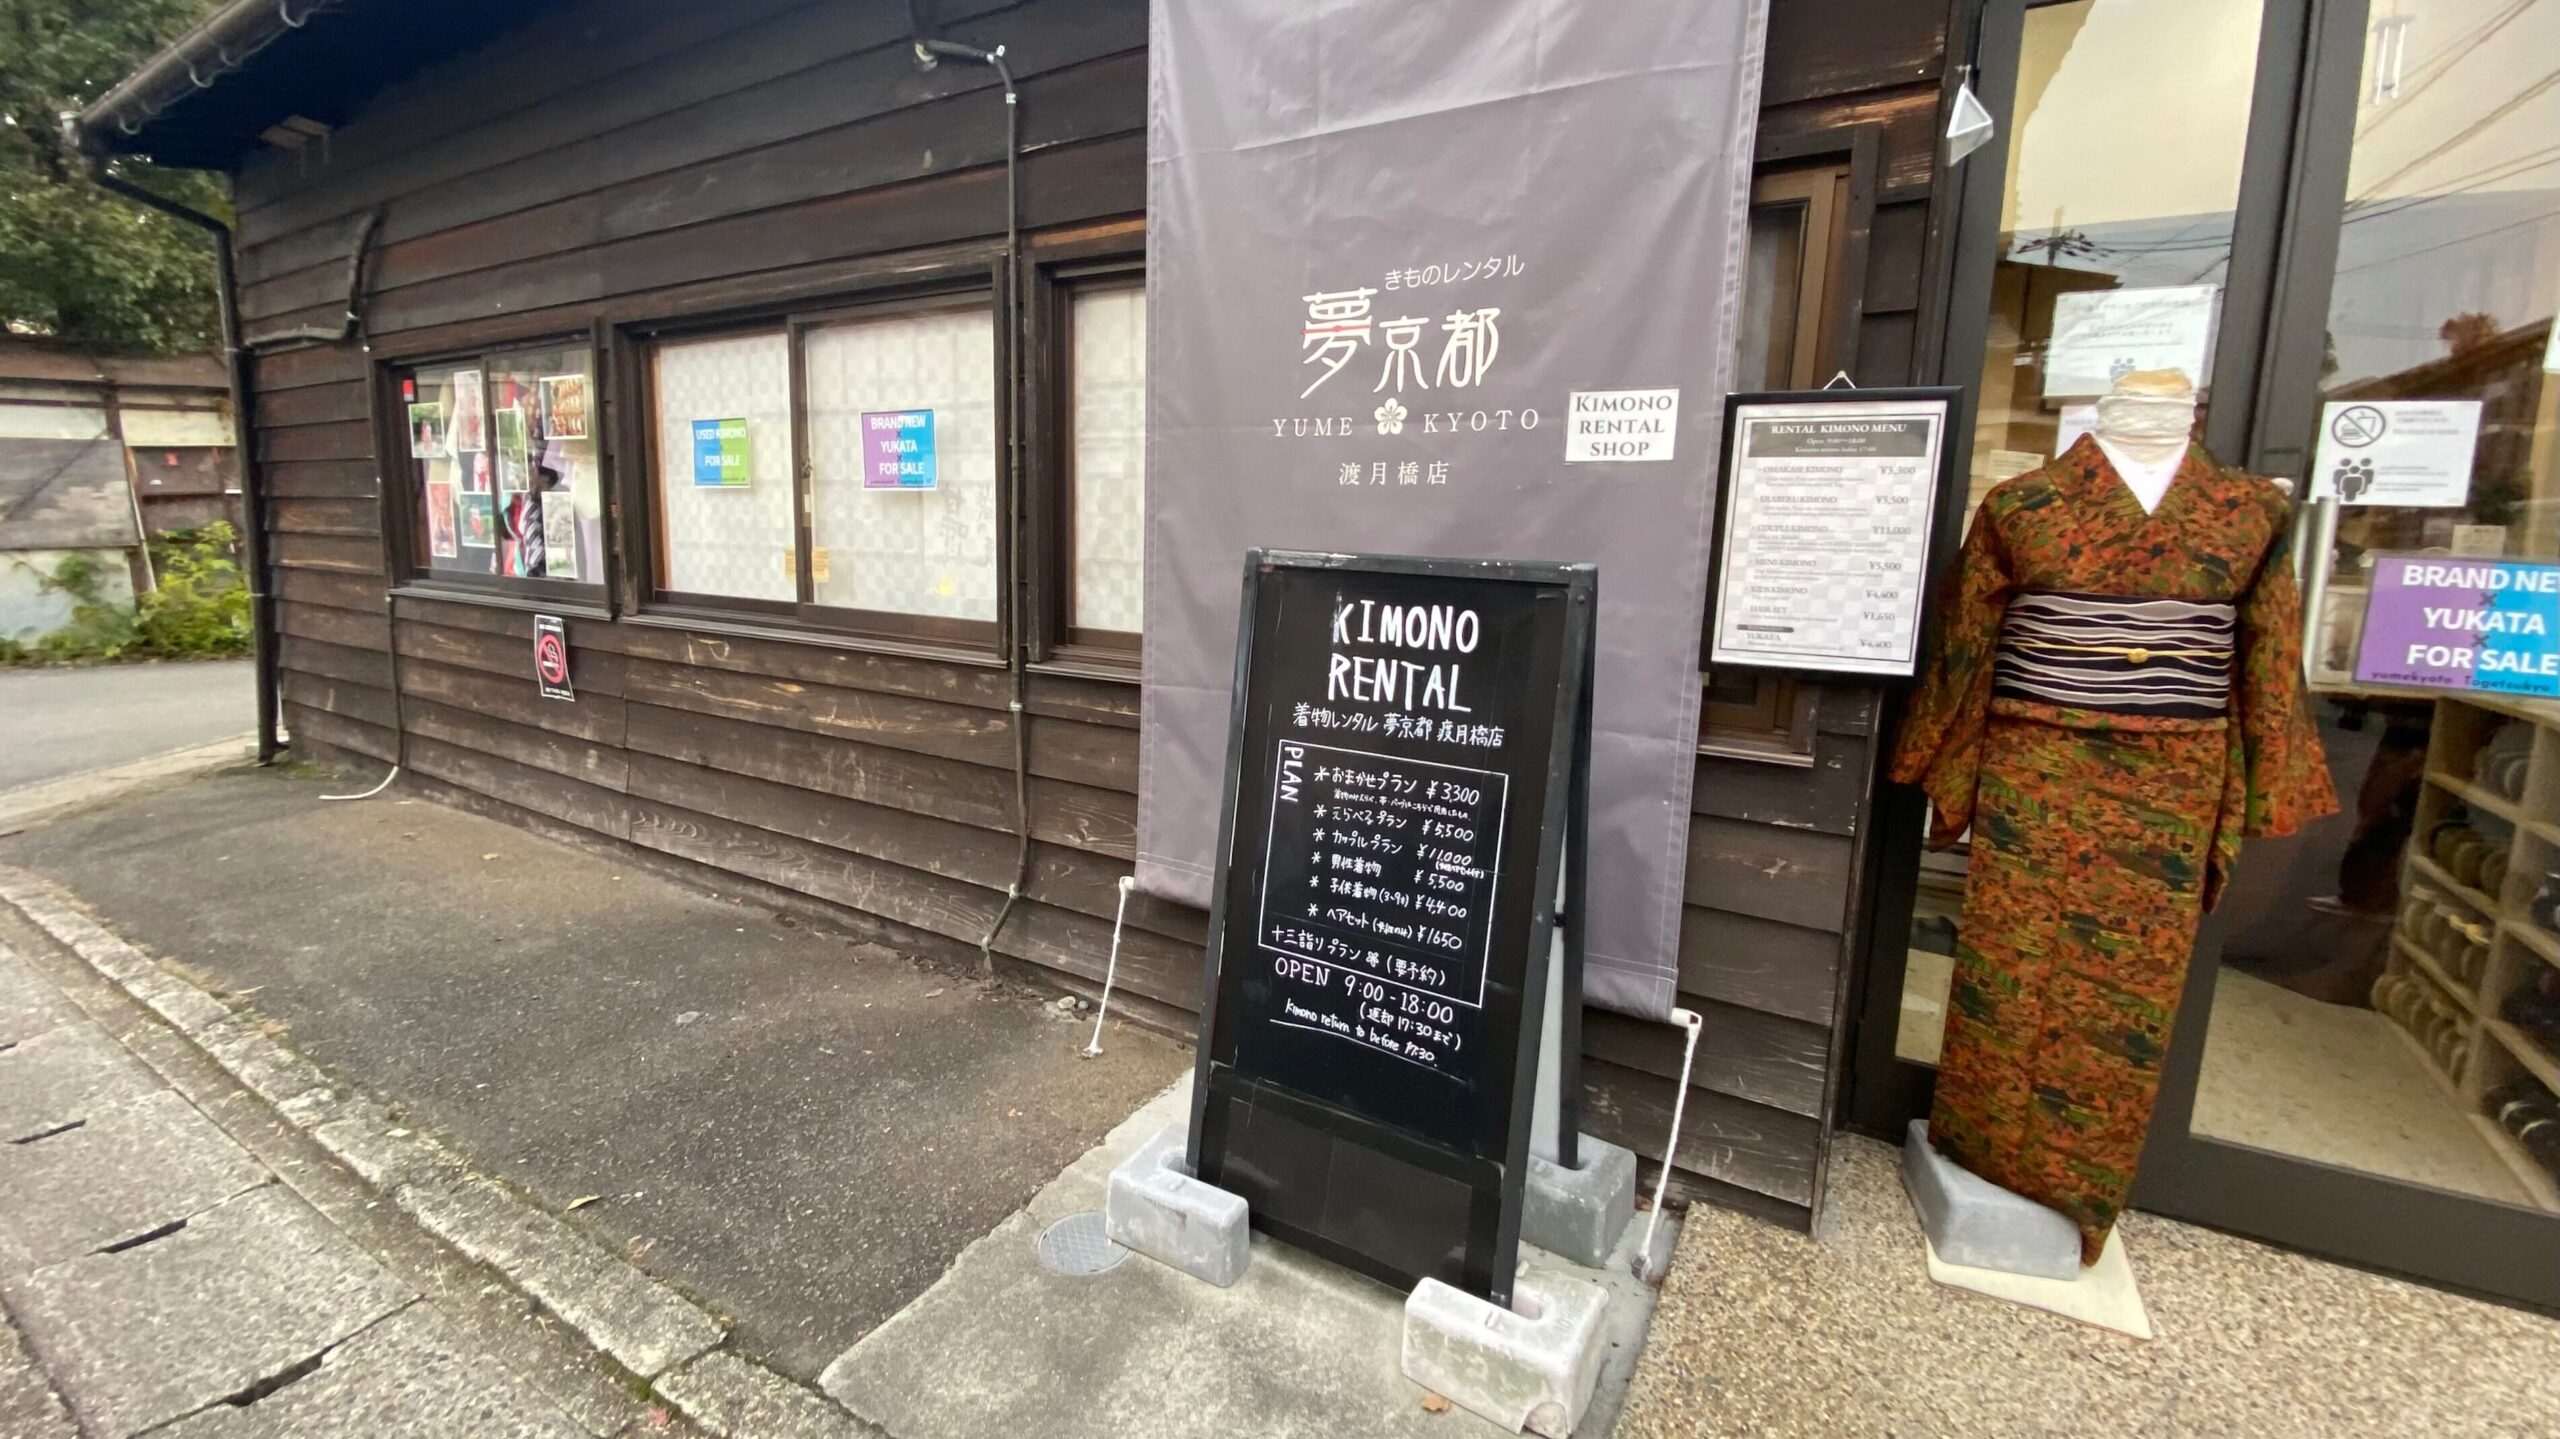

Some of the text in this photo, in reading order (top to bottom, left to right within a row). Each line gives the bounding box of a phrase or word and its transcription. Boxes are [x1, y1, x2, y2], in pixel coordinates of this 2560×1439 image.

[1385, 254, 1525, 291] きものレンタル
[1300, 286, 1501, 399] 夢京都
[871, 416, 902, 430] BRAND
[1272, 408, 1540, 438] YUME KYOTO
[1579, 418, 1666, 436] RENTAL
[1771, 424, 1908, 434] RENTAL KIMONO MENU
[880, 440, 918, 453] YUKATA
[1590, 441, 1650, 457] SHOP
[705, 455, 740, 467] FOR SALE
[879, 462, 925, 475] FOR SALE
[1337, 461, 1450, 486] 渡月橋店
[2402, 565, 2560, 593] BRAND NE
[1332, 599, 1480, 653] KIMONO
[2423, 607, 2546, 635] YUKATA
[2406, 644, 2560, 675] FOR SALE
[1328, 653, 1472, 712] RENTAL
[1293, 701, 1379, 732] 着物レンタル
[1384, 713, 1432, 741] 夢京都
[1280, 746, 1304, 802] PLAN
[1332, 766, 1417, 793] おまかせプラン
[1332, 806, 1407, 829] えらべるプラン
[1332, 829, 1403, 854] カップルプラン
[1330, 853, 1382, 877] 男性着物
[1275, 956, 1331, 987] OPEN
[1320, 1012, 1350, 1033] return
[1355, 1024, 1366, 1037] to
[1370, 1027, 1400, 1051] before
